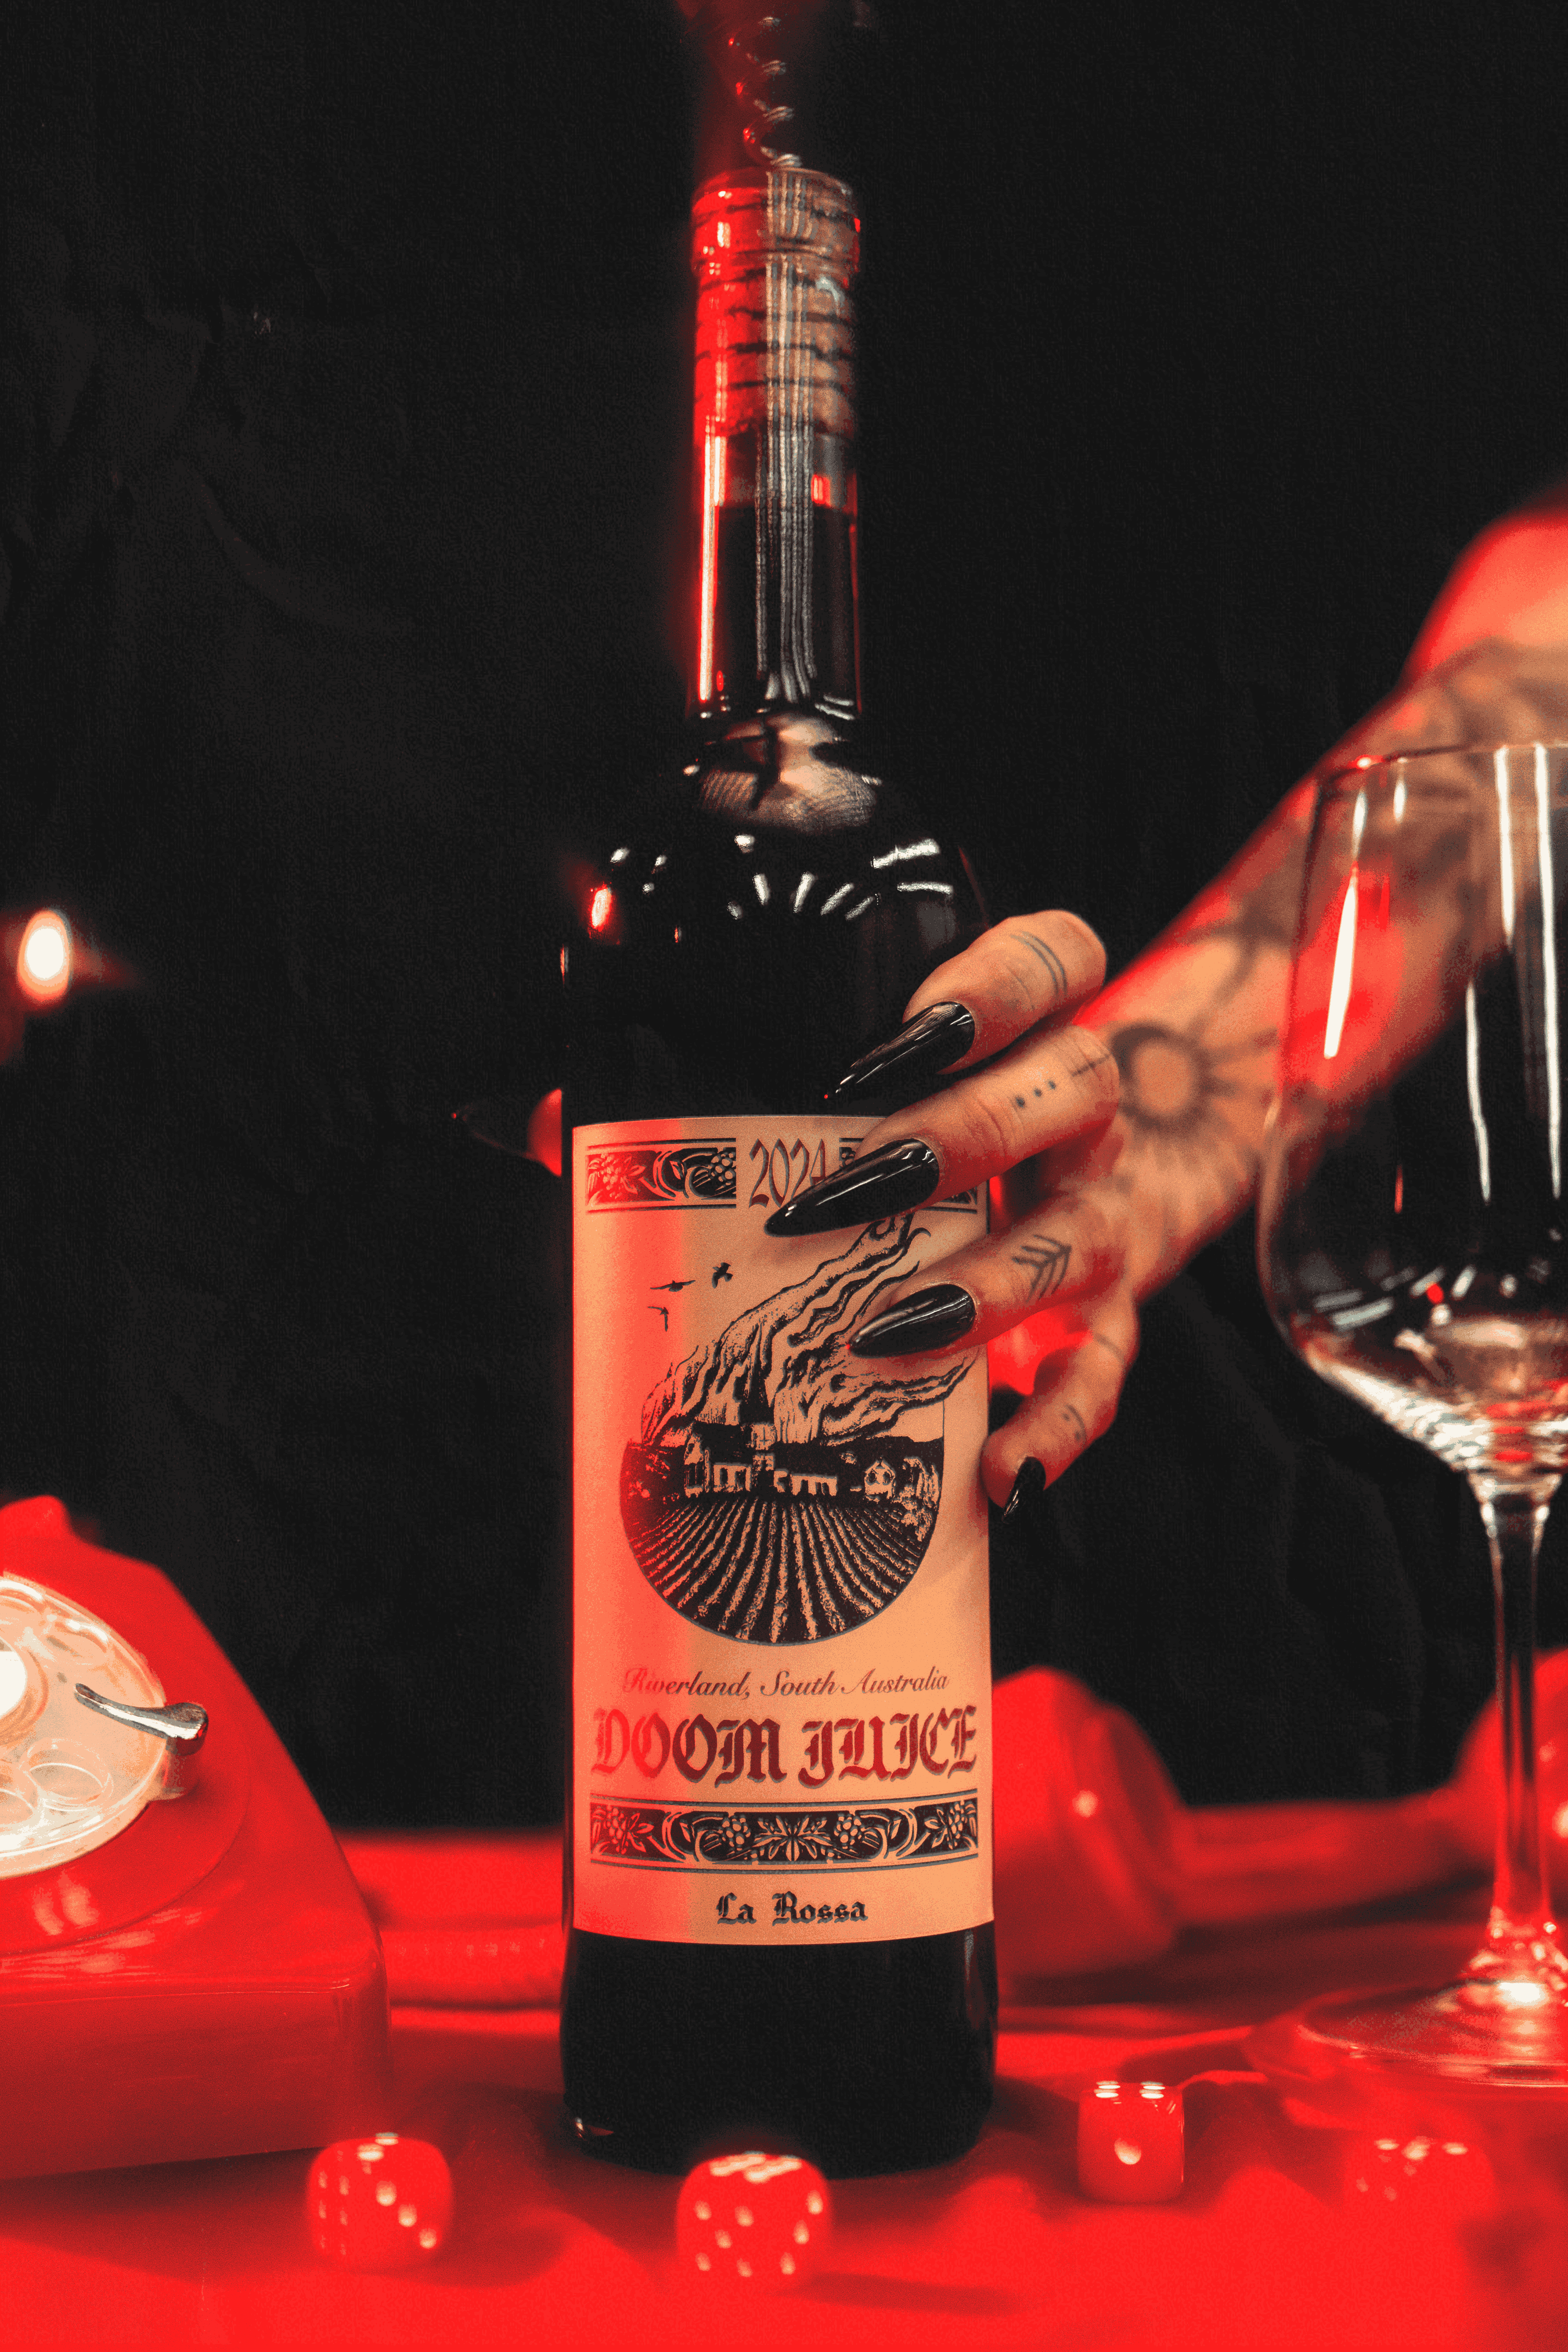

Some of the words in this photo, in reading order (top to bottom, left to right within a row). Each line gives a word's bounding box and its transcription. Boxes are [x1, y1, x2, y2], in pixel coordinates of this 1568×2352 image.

[749, 1138, 826, 1208] 2024
[623, 1667, 752, 1700] Riverland,
[760, 1670, 840, 1696] South
[841, 1666, 950, 1694] Australia
[591, 1708, 787, 1788] DOOM
[798, 1704, 976, 1789] JUICE
[716, 1892, 757, 1925] La
[772, 1891, 868, 1926] Rossa
